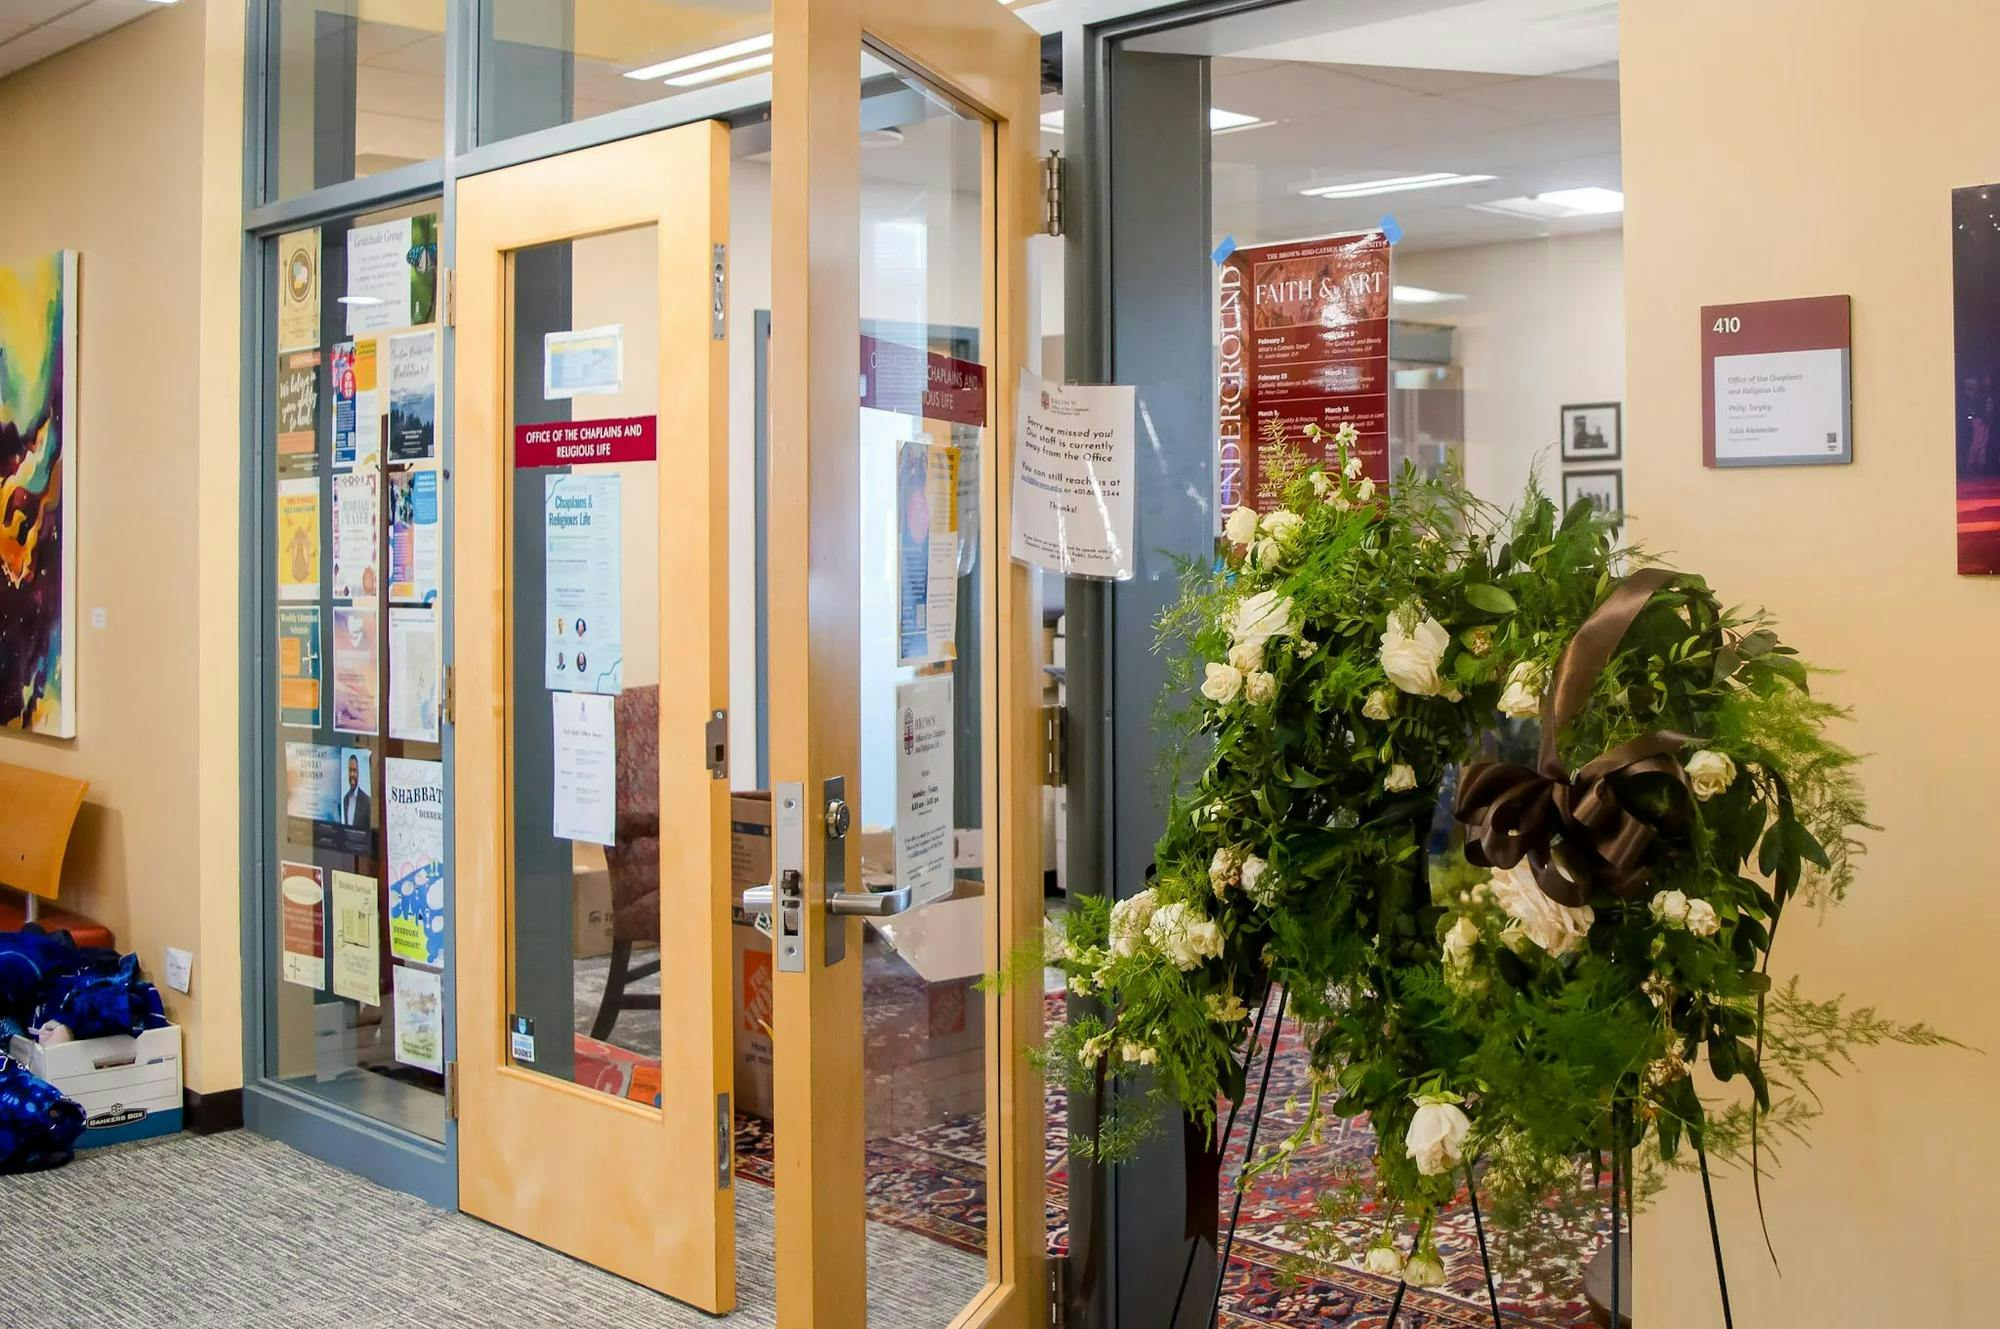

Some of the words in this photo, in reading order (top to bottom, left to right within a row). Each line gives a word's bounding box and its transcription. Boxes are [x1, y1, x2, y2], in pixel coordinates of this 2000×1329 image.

[354, 232, 382, 248] Gratitude
[384, 230, 404, 242] Group
[1267, 252, 1278, 260] THE
[1255, 280, 1312, 305] FAITH
[1343, 272, 1384, 297] ART
[1712, 316, 1741, 334] 410
[1258, 338, 1280, 346] February
[926, 365, 963, 389] CHAPLAINS
[964, 374, 978, 391] AND
[1219, 264, 1242, 519] UNDERGROUND
[941, 392, 954, 410] LIFE
[1325, 406, 1342, 414] March
[1258, 410, 1274, 418] March
[526, 430, 551, 444] OFFICE
[552, 429, 563, 441] OF
[564, 428, 578, 441] THE
[579, 425, 622, 441] CHAPLAINS
[623, 424, 643, 436] AND
[1027, 415, 1043, 431] Sorry
[1045, 426, 1055, 434] we
[1057, 428, 1090, 438] missed
[1093, 428, 1113, 440] you!
[1026, 427, 1037, 438] Our
[1040, 434, 1056, 446] staff
[1060, 440, 1067, 448] is
[1069, 440, 1113, 452] currently
[556, 445, 594, 458] RELIGIOUS
[596, 443, 611, 456] LIFE
[1025, 440, 1040, 453] away
[1042, 445, 1061, 457] from
[1064, 452, 1079, 461] the
[1083, 452, 1115, 463] Office.
[1021, 461, 1032, 473] You
[1034, 467, 1046, 478] can
[1048, 472, 1063, 483] still
[1066, 476, 1091, 486] reach
[1110, 477, 1121, 487] at
[555, 495, 587, 511] Chaplains
[588, 494, 593, 509] &
[1049, 501, 1078, 513] Thnks!
[549, 512, 579, 529] Religious
[580, 511, 592, 526] Life
[392, 786, 443, 805] SHABBAT
[89, 1114, 126, 1127] BANKERS
[127, 1111, 144, 1120] BOX
